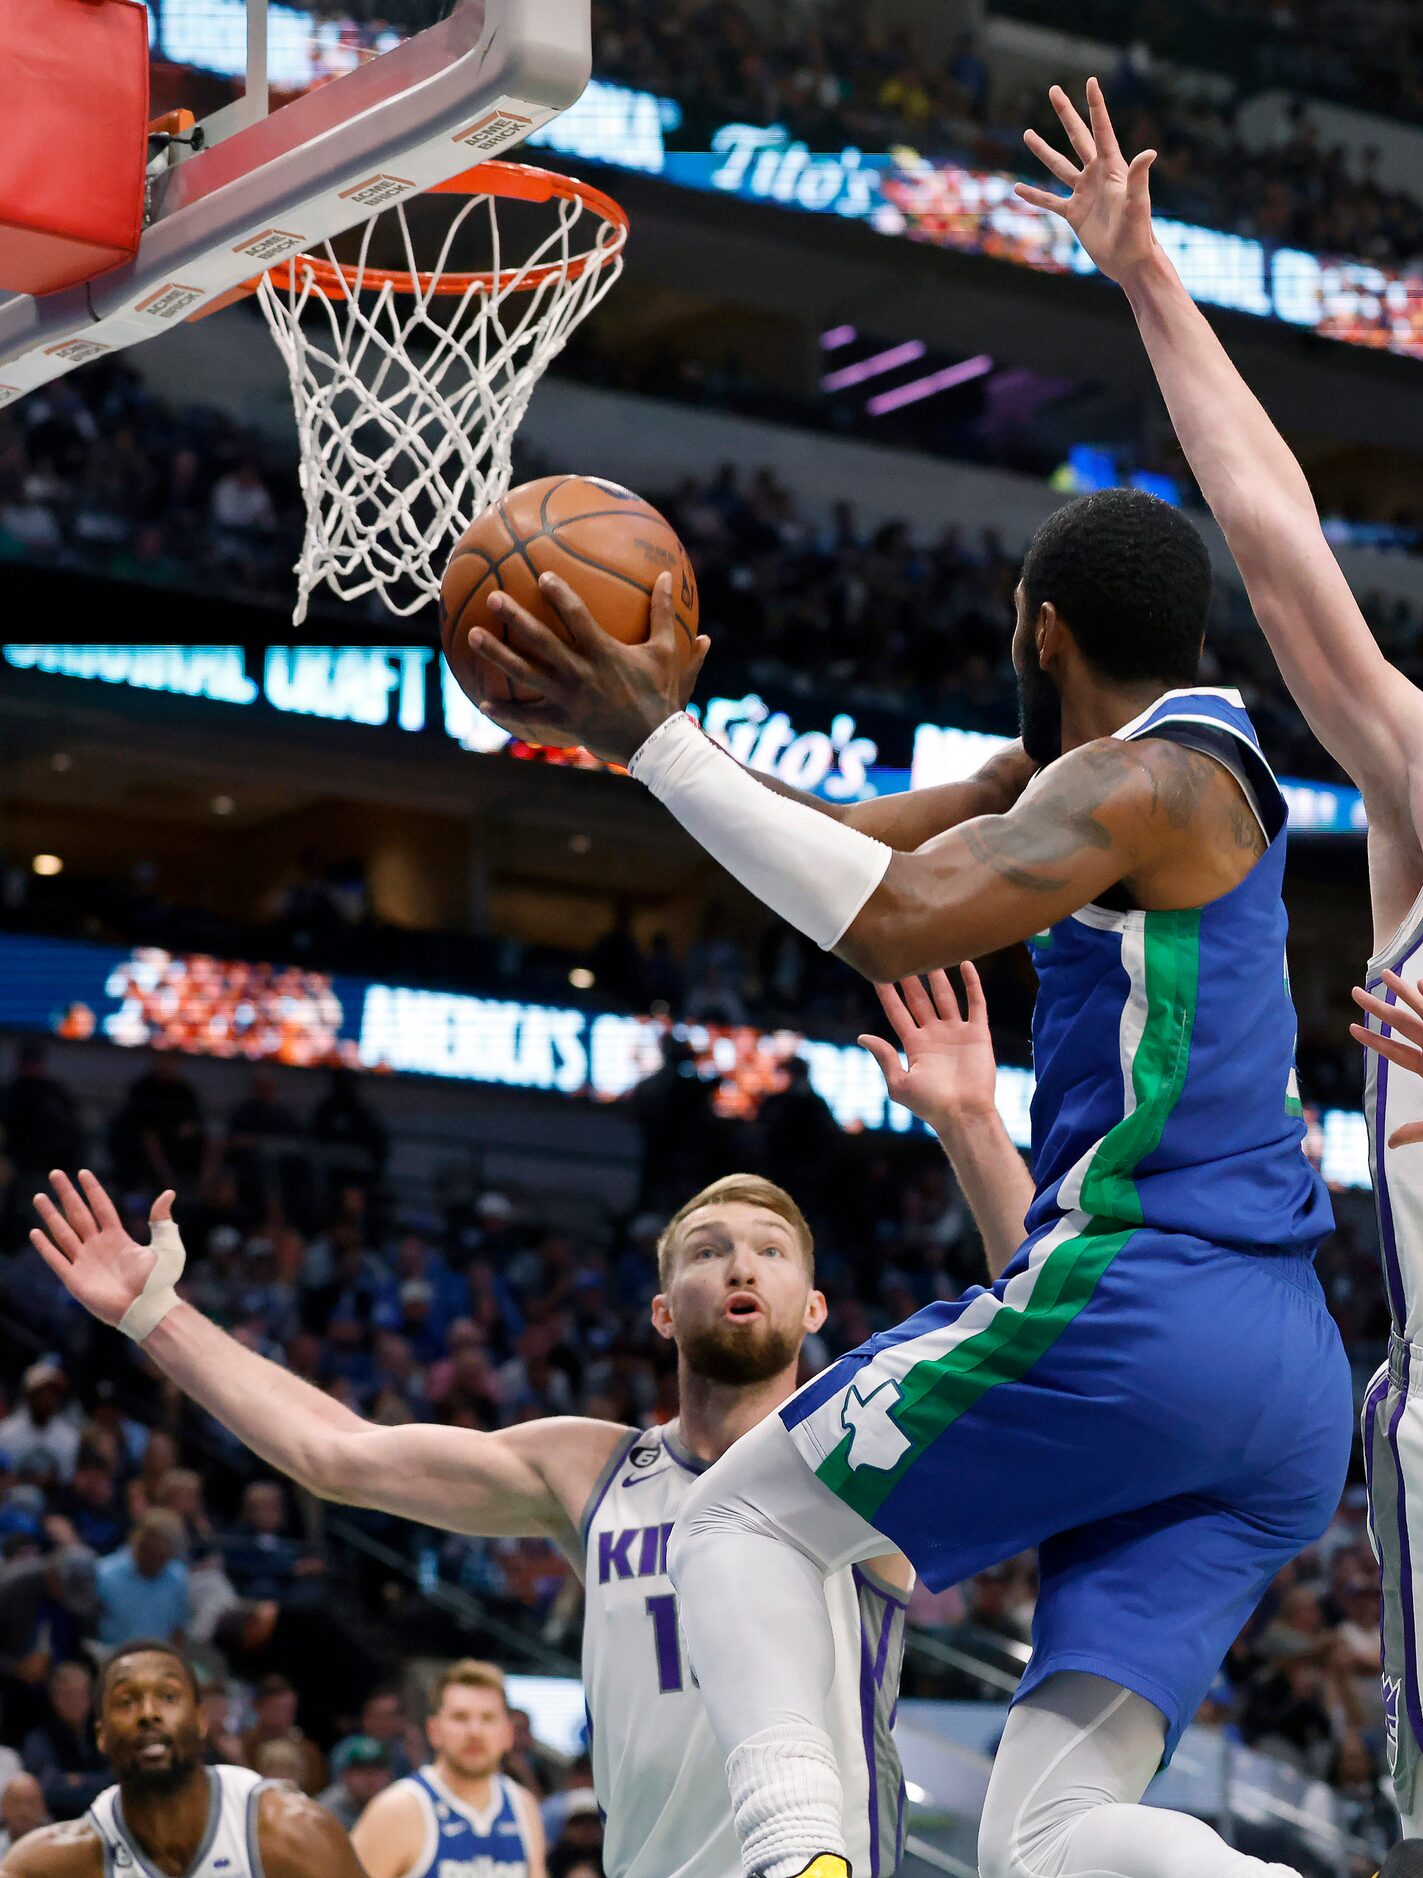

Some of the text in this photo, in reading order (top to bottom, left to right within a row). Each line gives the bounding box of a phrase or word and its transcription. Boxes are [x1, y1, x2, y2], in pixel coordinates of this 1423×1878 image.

[464, 118, 512, 147] ACME
[477, 122, 526, 151] BRICK
[712, 124, 879, 216] Tito's
[351, 180, 396, 203] ACME
[363, 184, 410, 207] BRICK
[245, 234, 287, 257] ACME
[257, 238, 300, 261] BRICK
[687, 694, 877, 800] Tito's
[636, 1448, 655, 1467] 6
[645, 1593, 701, 1694] 1
